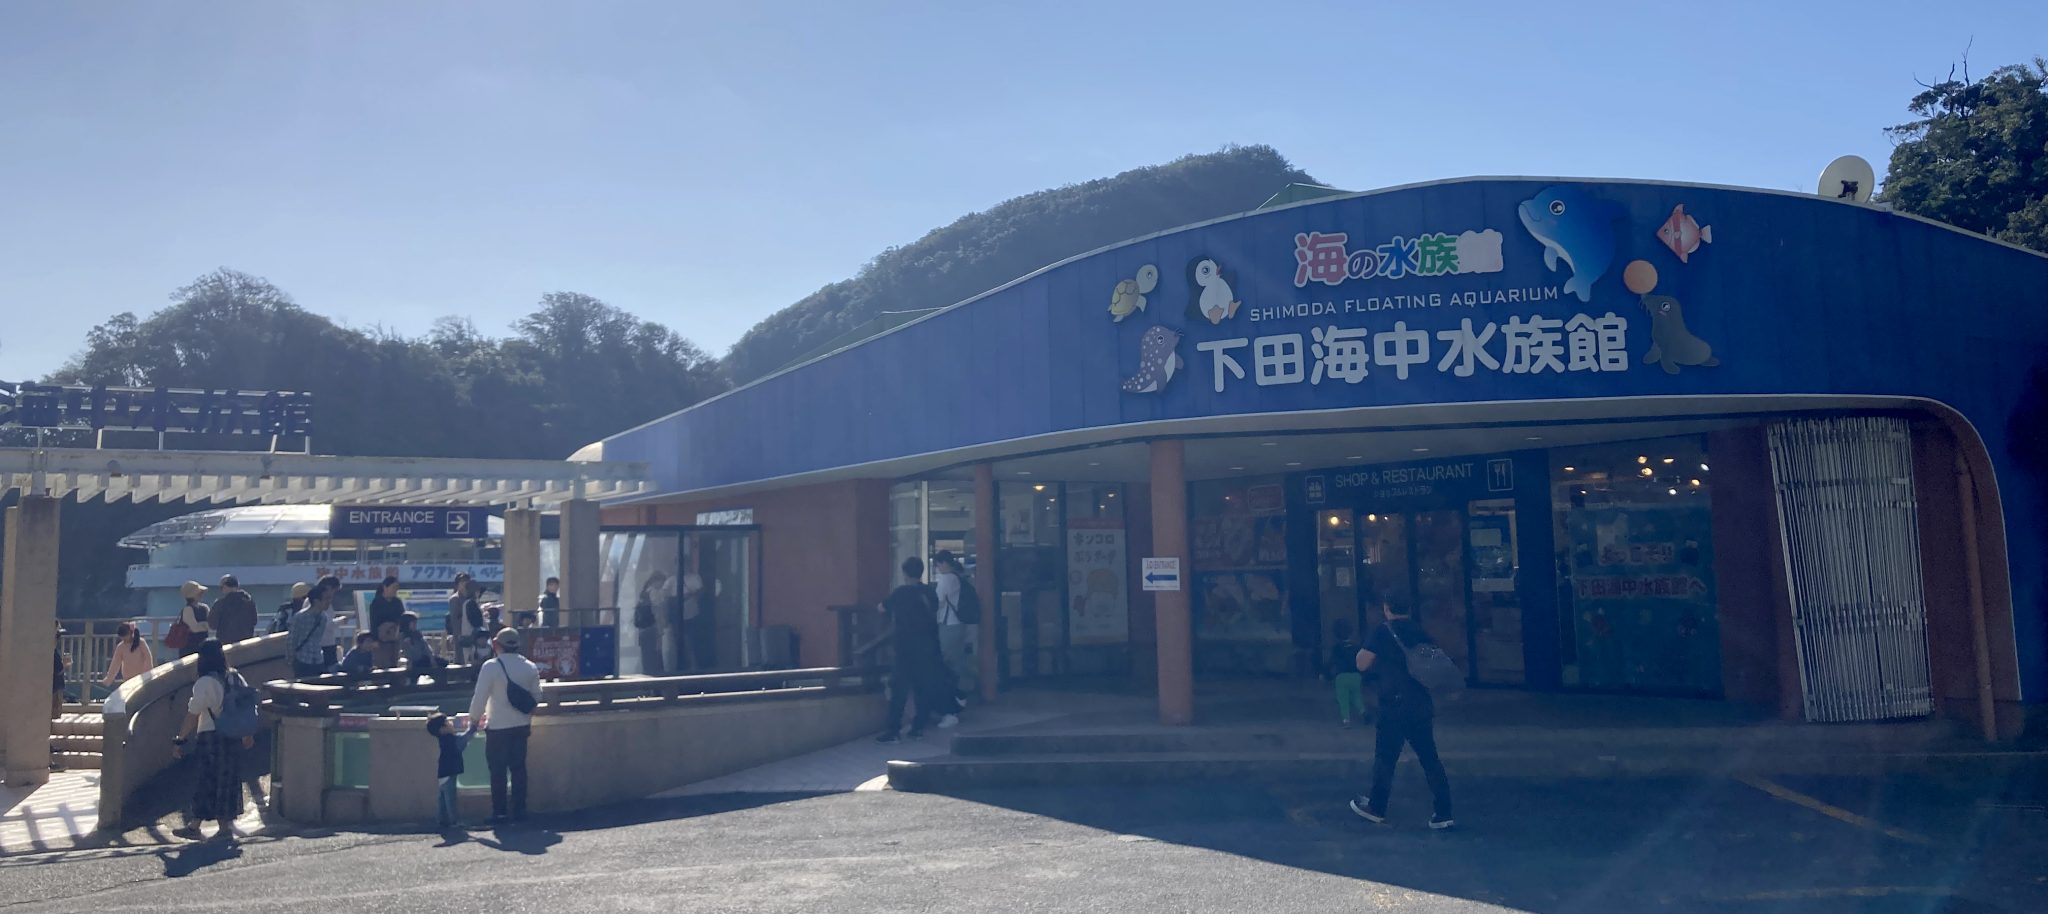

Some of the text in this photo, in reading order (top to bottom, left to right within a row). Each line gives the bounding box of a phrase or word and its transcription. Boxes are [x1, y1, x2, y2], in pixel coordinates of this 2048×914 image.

[1294, 229, 1503, 287] 海の水族
[1250, 286, 1558, 322] SHIMODA FLOATING AQUARIUM
[1196, 311, 1629, 393] 下田海中水族館
[1335, 463, 1474, 488] SHOP & RESTAURANT
[349, 511, 434, 524] ENTRANCE
